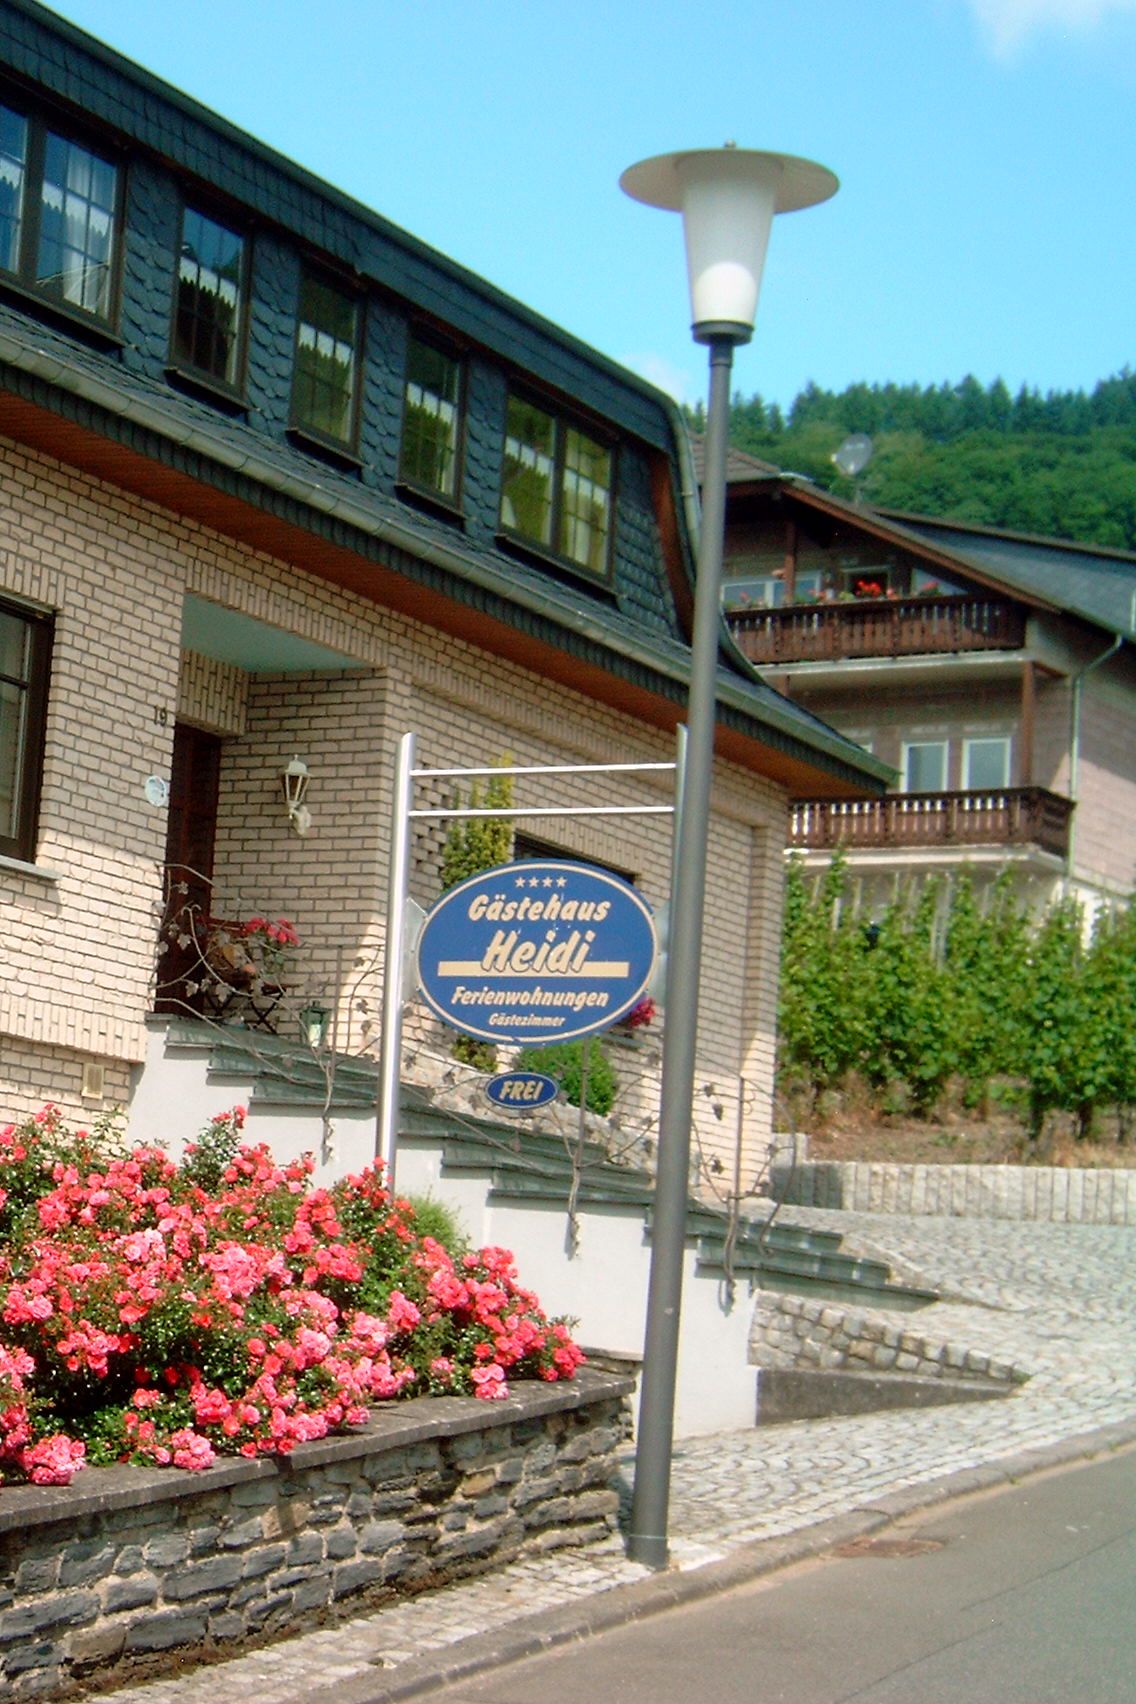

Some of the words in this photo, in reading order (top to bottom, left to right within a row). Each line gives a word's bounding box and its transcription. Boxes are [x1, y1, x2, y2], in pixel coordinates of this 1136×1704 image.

[153, 706, 167, 726] 19
[468, 894, 611, 921] Gästehaus
[481, 930, 596, 973] Heidi
[451, 987, 609, 1011] Ferienwohnungen
[489, 1013, 565, 1027] Gästezimmer
[499, 1081, 543, 1101] FREI
